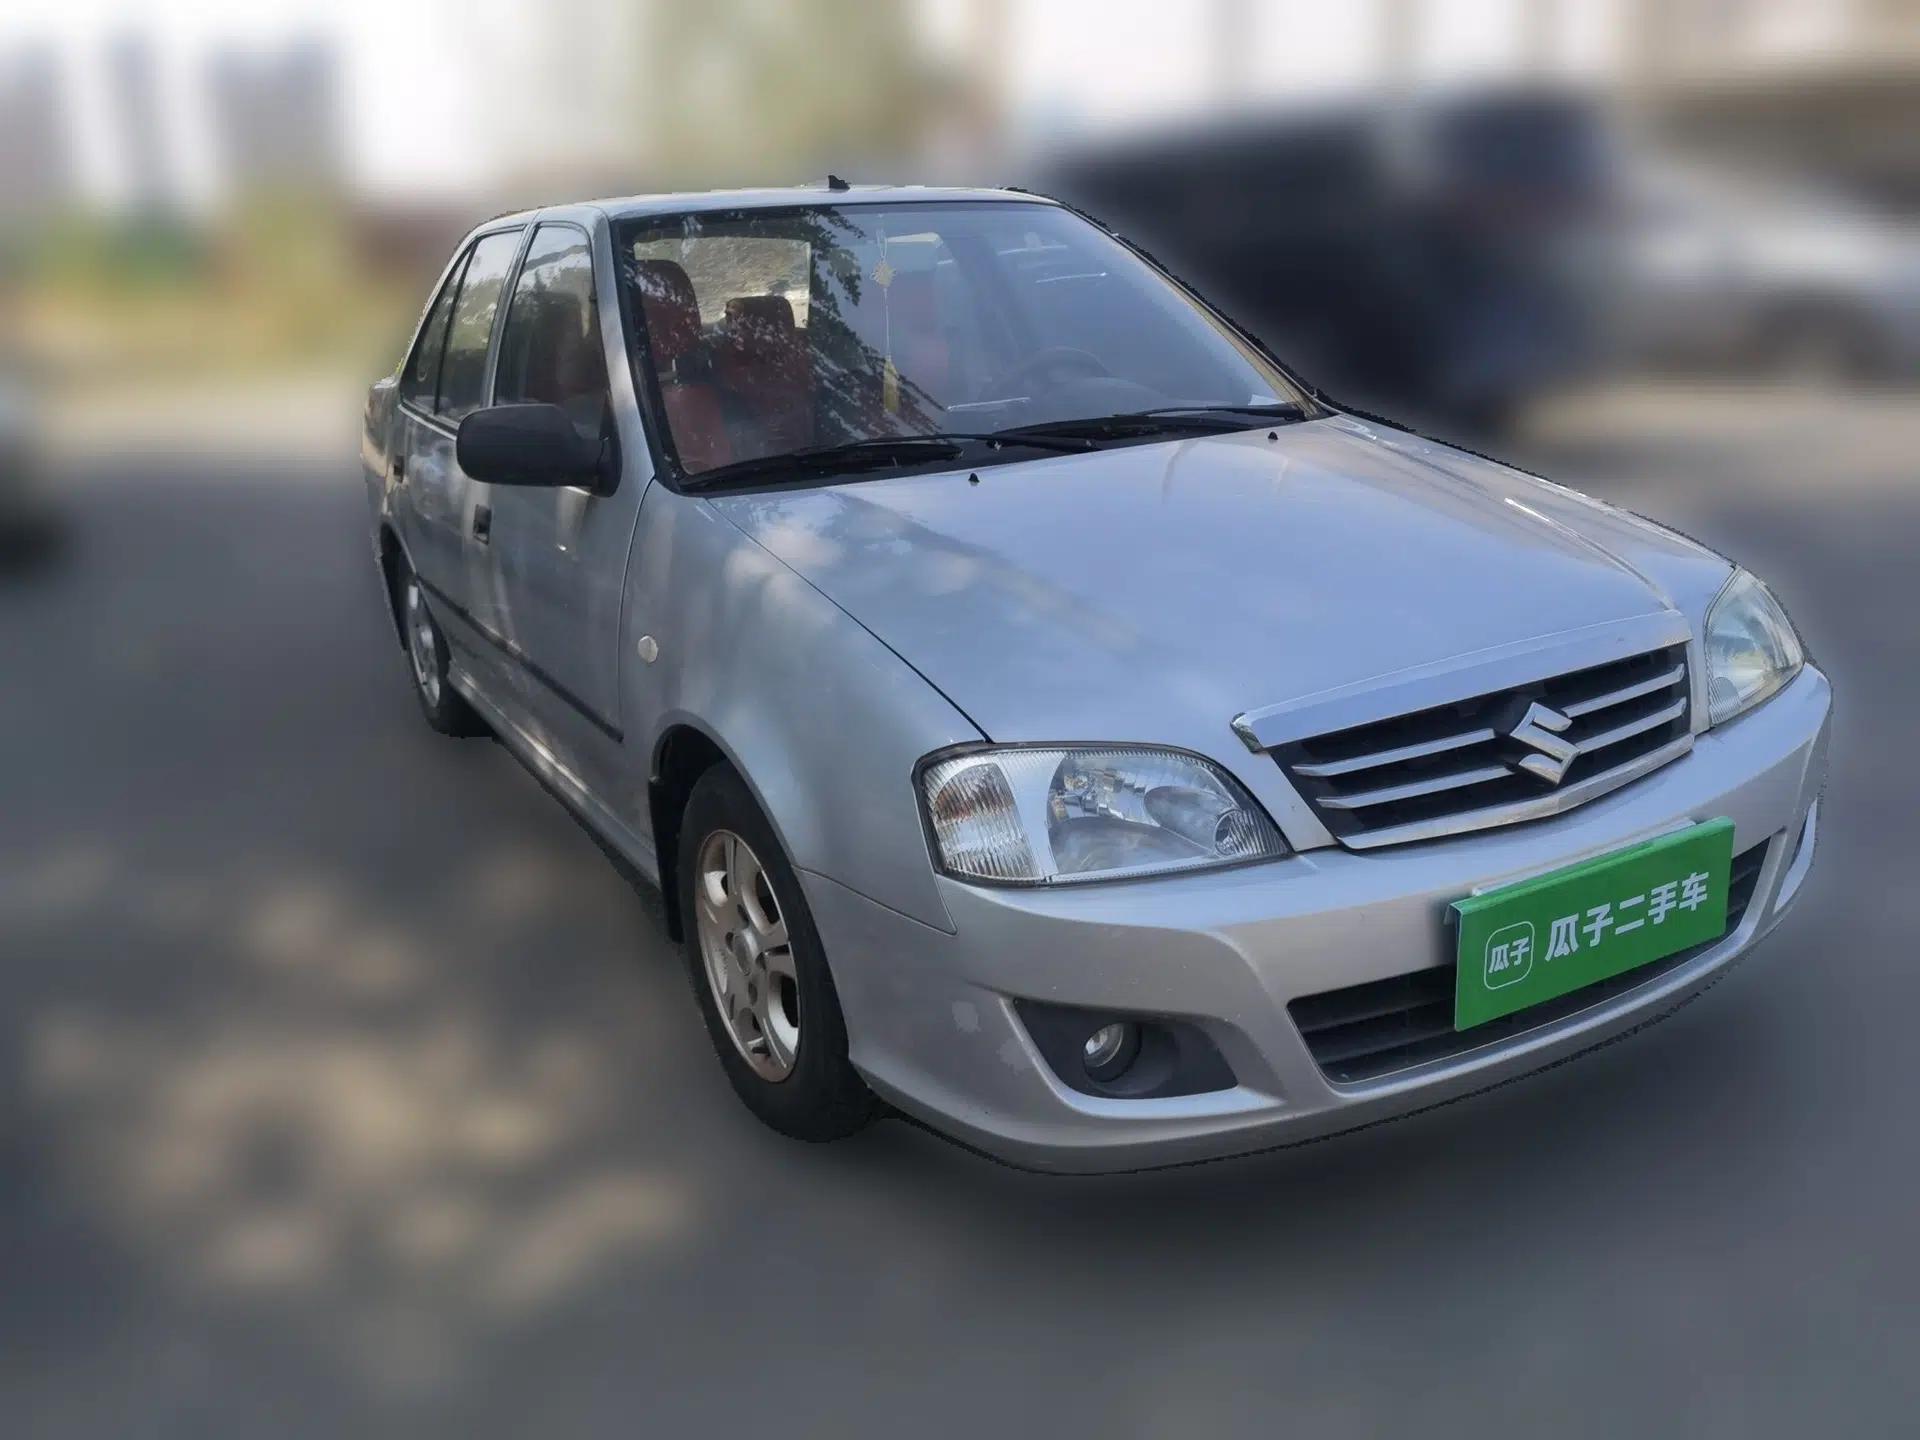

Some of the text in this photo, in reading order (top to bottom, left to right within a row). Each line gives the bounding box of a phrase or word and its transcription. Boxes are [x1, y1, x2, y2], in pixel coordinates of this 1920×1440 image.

[1545, 872, 1709, 961] 瓜子二手车
[1488, 937, 1530, 974] 瓜子
